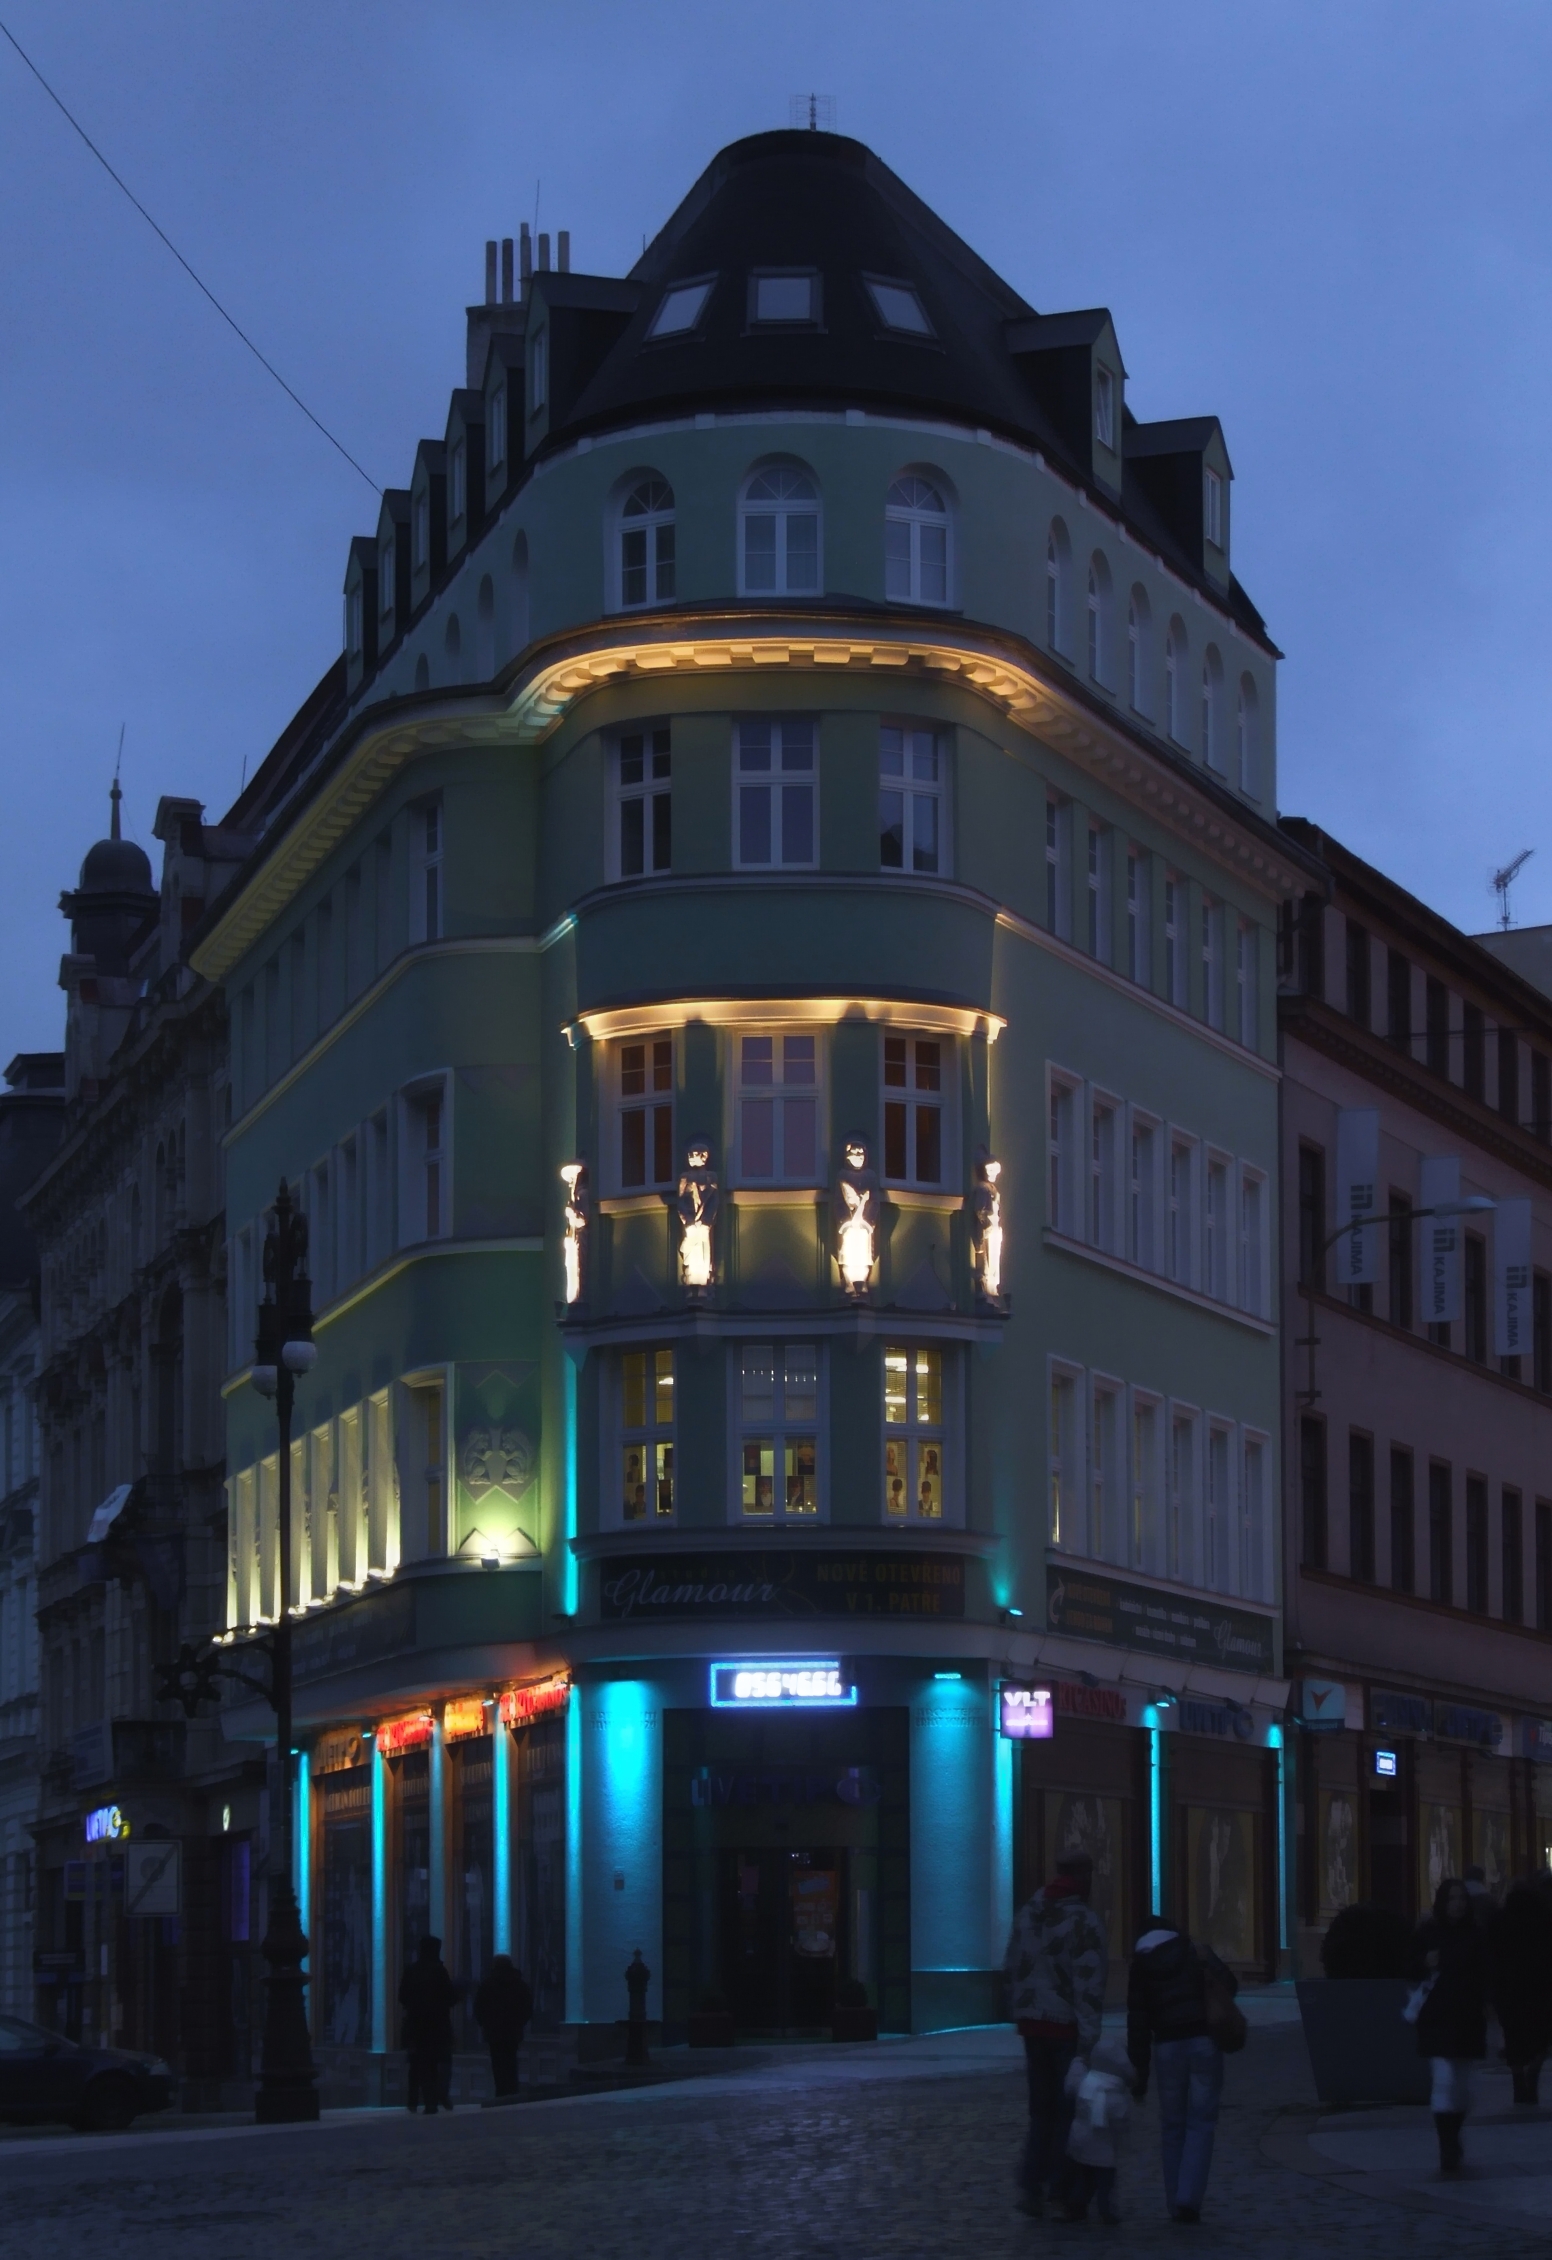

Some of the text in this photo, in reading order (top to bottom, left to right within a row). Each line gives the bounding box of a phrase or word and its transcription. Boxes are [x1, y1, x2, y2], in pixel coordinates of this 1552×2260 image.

[1433, 1255, 1445, 1315] KAJIMA
[1507, 1292, 1519, 1349] KAJIMA
[604, 1568, 775, 1618] Glamour
[816, 1560, 962, 1585] NOVĚ OTEVŘENO
[846, 1593, 858, 1611] V
[889, 1589, 940, 1613] PATŘE
[1213, 1619, 1263, 1660] Glamour
[1003, 1691, 1051, 1707] VLT
